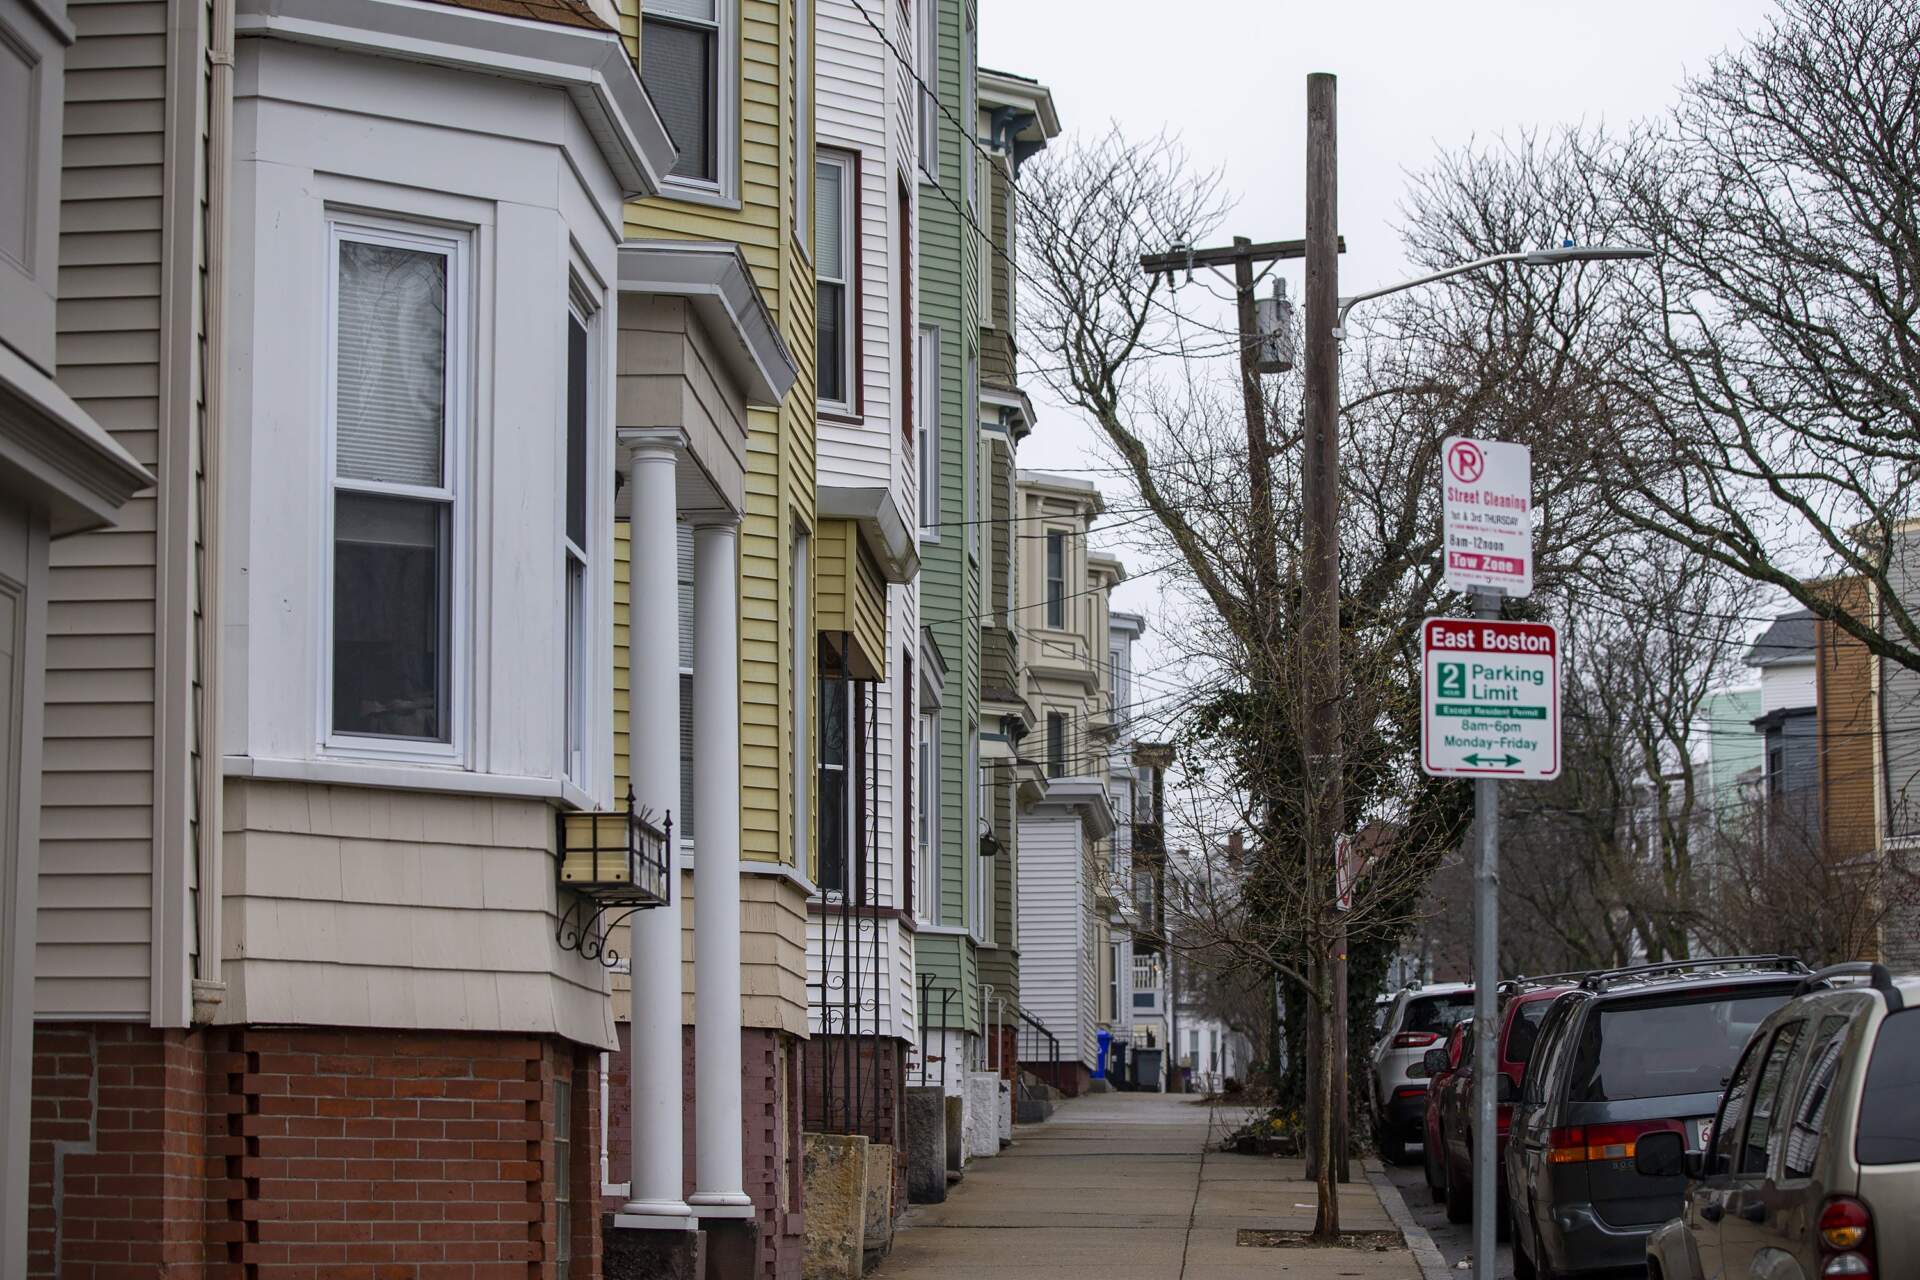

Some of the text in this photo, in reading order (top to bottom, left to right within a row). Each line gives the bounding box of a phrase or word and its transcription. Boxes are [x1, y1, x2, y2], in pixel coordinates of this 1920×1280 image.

[1448, 487, 1526, 512] Street Cleaning
[1484, 514, 1518, 526] THURSDAY
[1452, 553, 1514, 572] Tow Zone
[1432, 627, 1550, 651] East Boston
[1443, 664, 1459, 688] 2
[1472, 664, 1544, 685] Parking
[1472, 684, 1518, 701] Limit
[1443, 706, 1472, 716] Except
[1474, 708, 1511, 717] Resident
[1461, 719, 1521, 733] 8am-6pm
[1444, 735, 1537, 751] Monday-Friday
